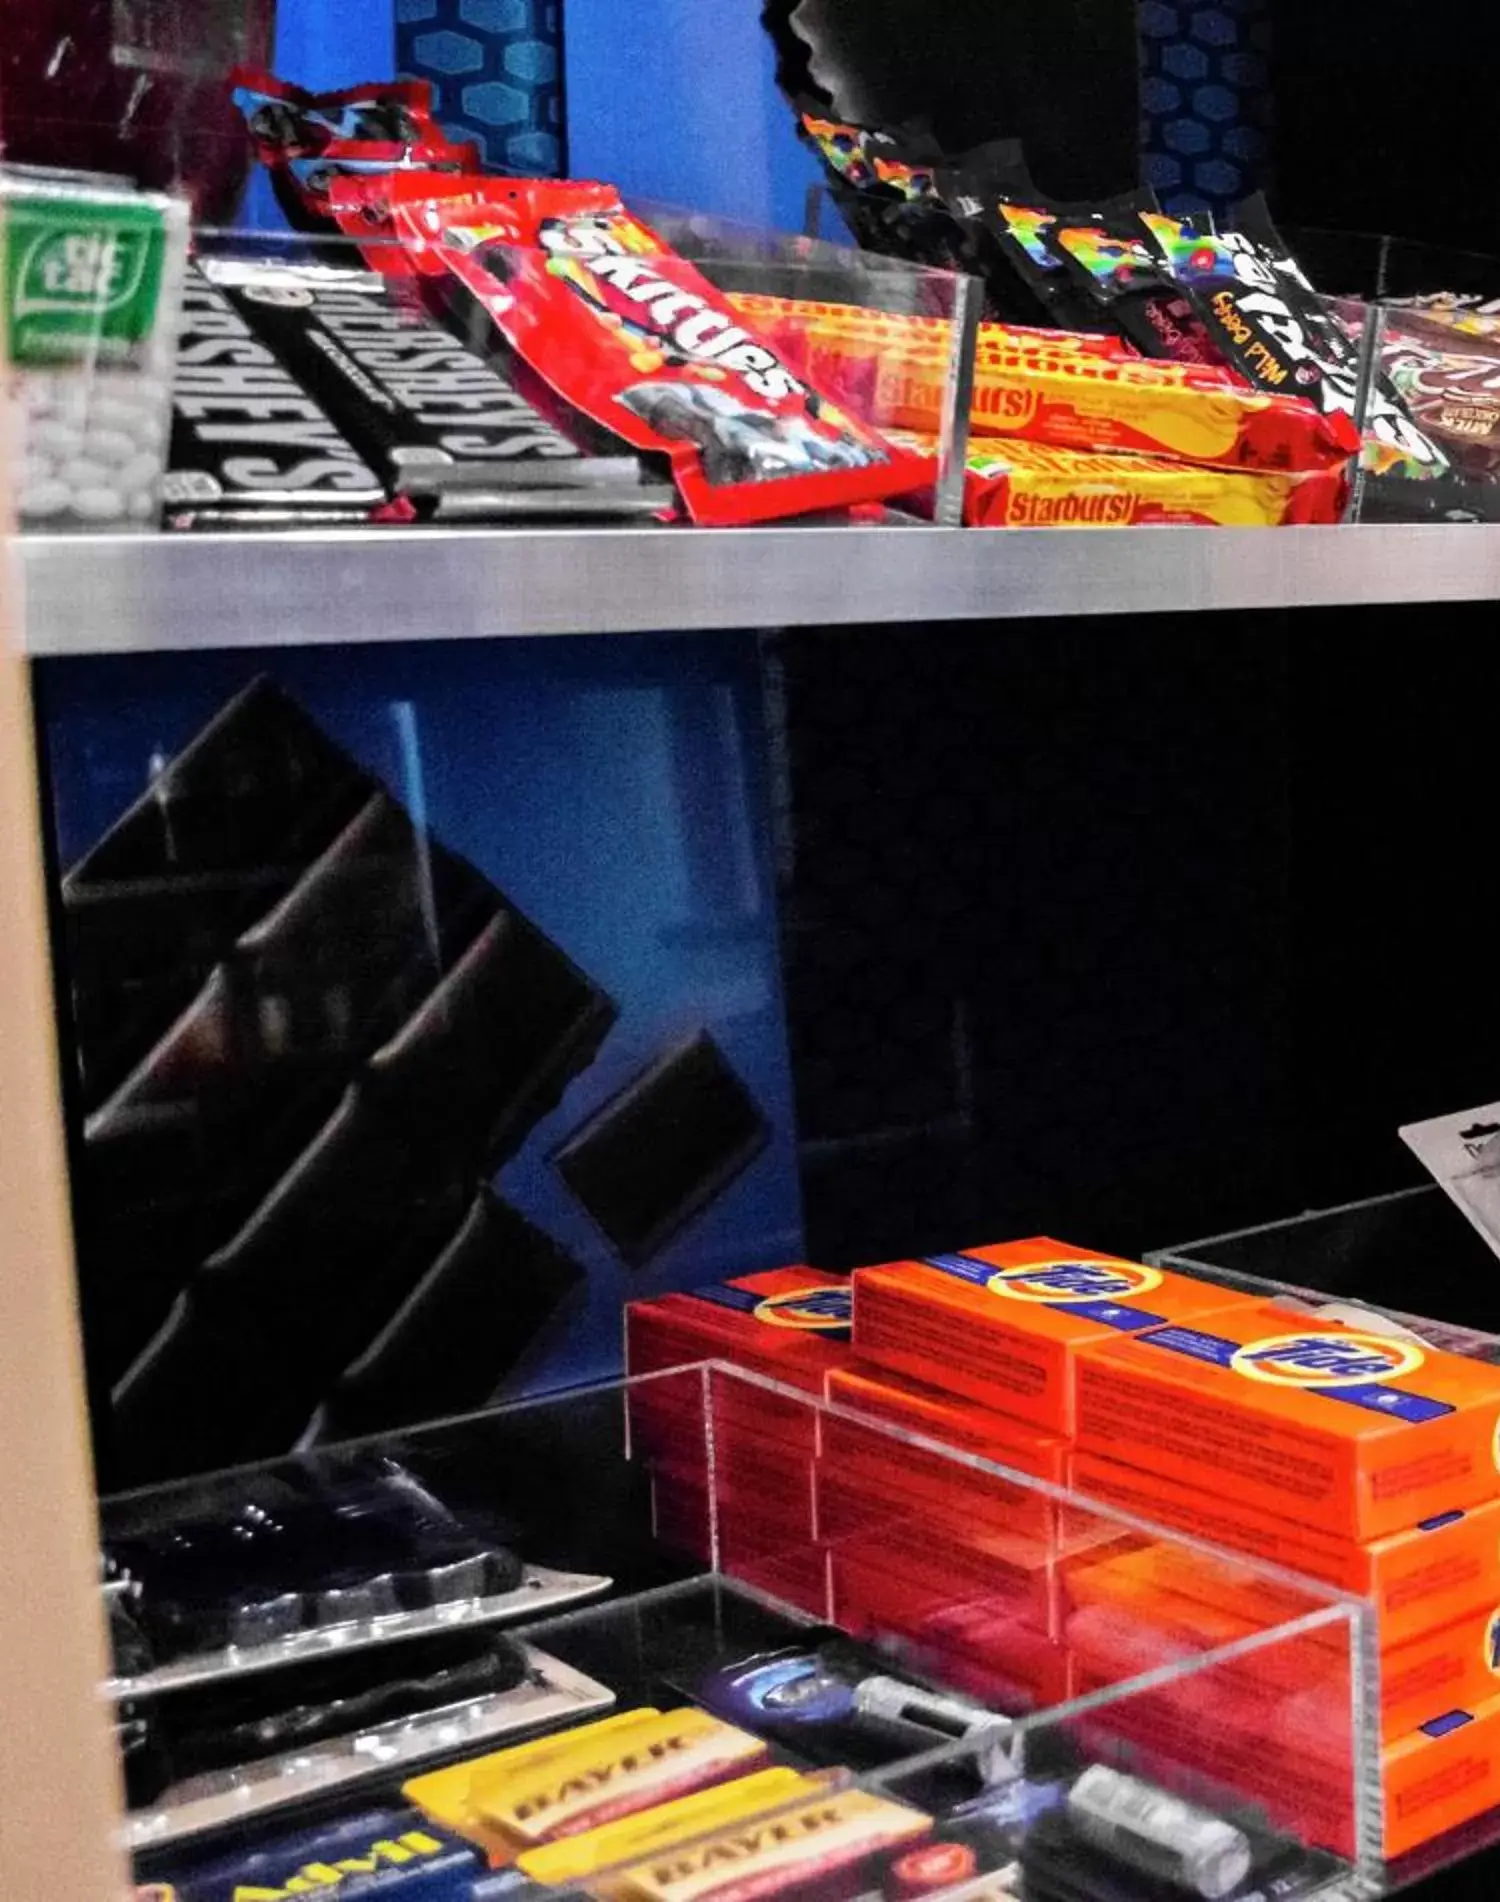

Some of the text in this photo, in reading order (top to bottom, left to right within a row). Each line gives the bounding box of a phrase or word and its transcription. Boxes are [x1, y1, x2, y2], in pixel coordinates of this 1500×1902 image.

[998, 1262, 1132, 1297] Tide
[1240, 1336, 1395, 1377] Tide
[513, 1733, 684, 1823] BAYER
[651, 1806, 843, 1887] BAYER
